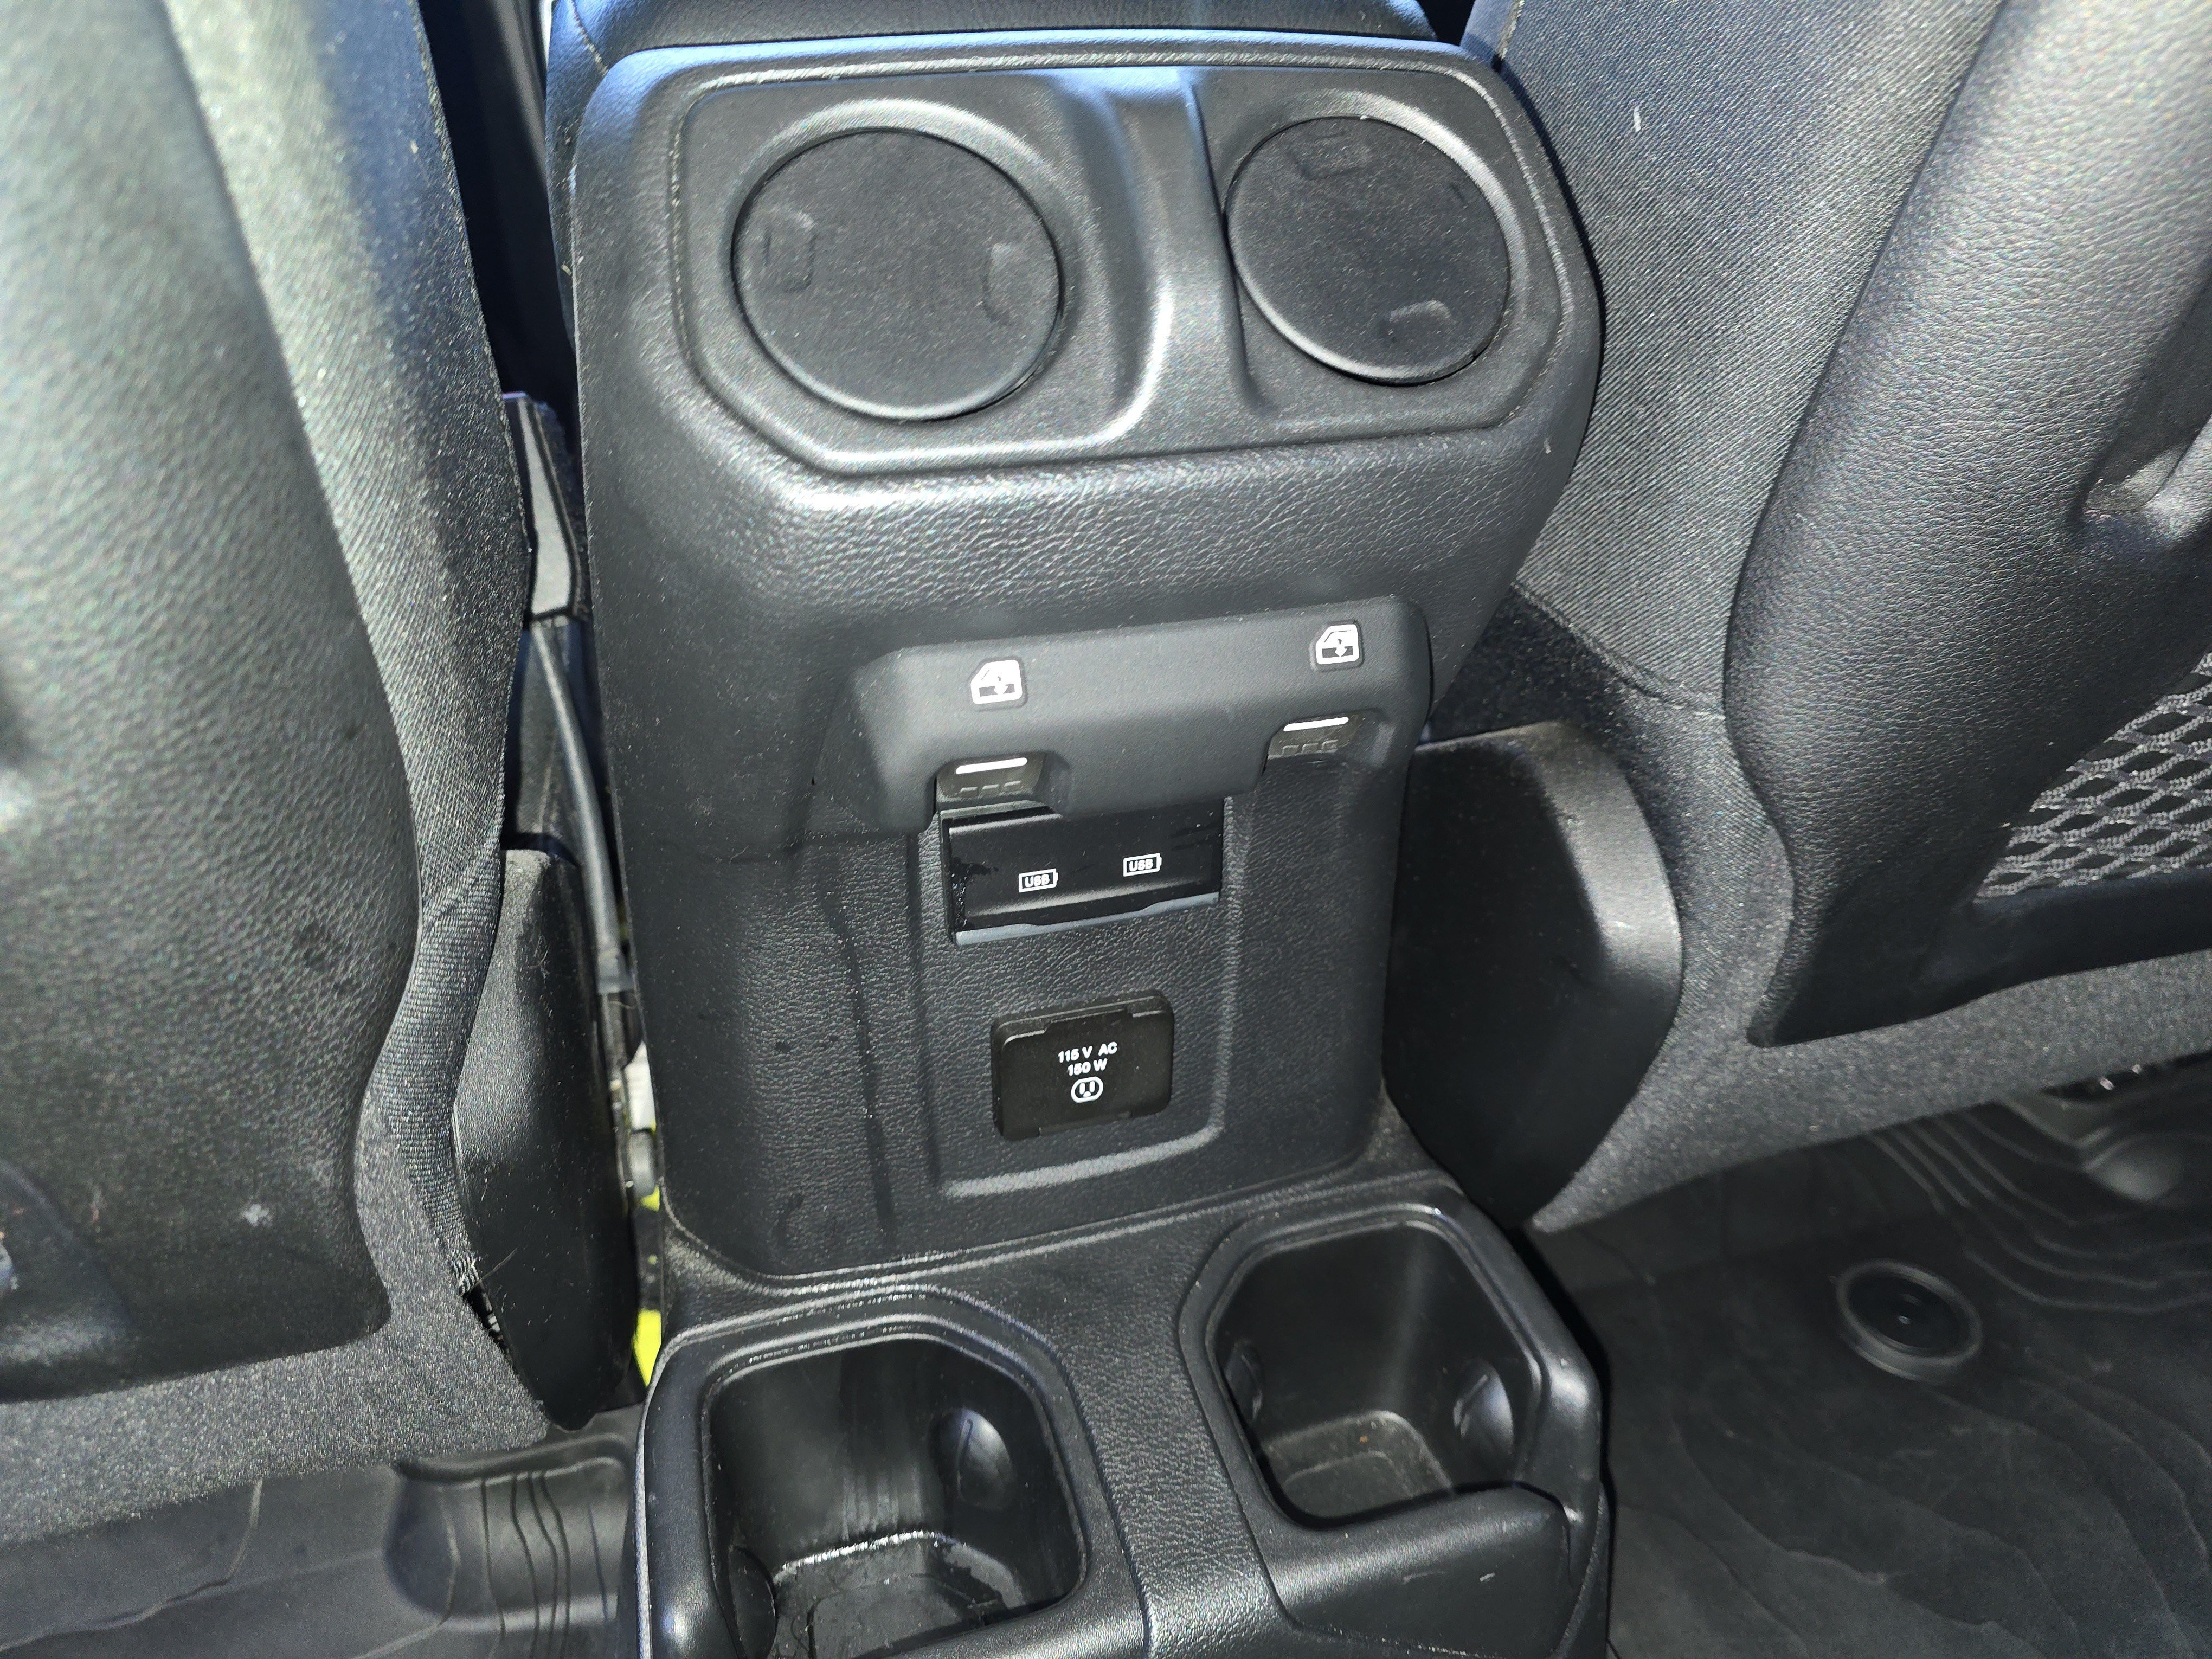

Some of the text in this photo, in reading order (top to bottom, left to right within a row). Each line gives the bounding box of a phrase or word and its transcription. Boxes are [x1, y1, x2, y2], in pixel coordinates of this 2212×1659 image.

[1129, 858, 1154, 872] USB
[1025, 874, 1050, 888] USB
[1058, 1041, 1117, 1063] 115 V AC
[1067, 1058, 1108, 1076] 150 W
